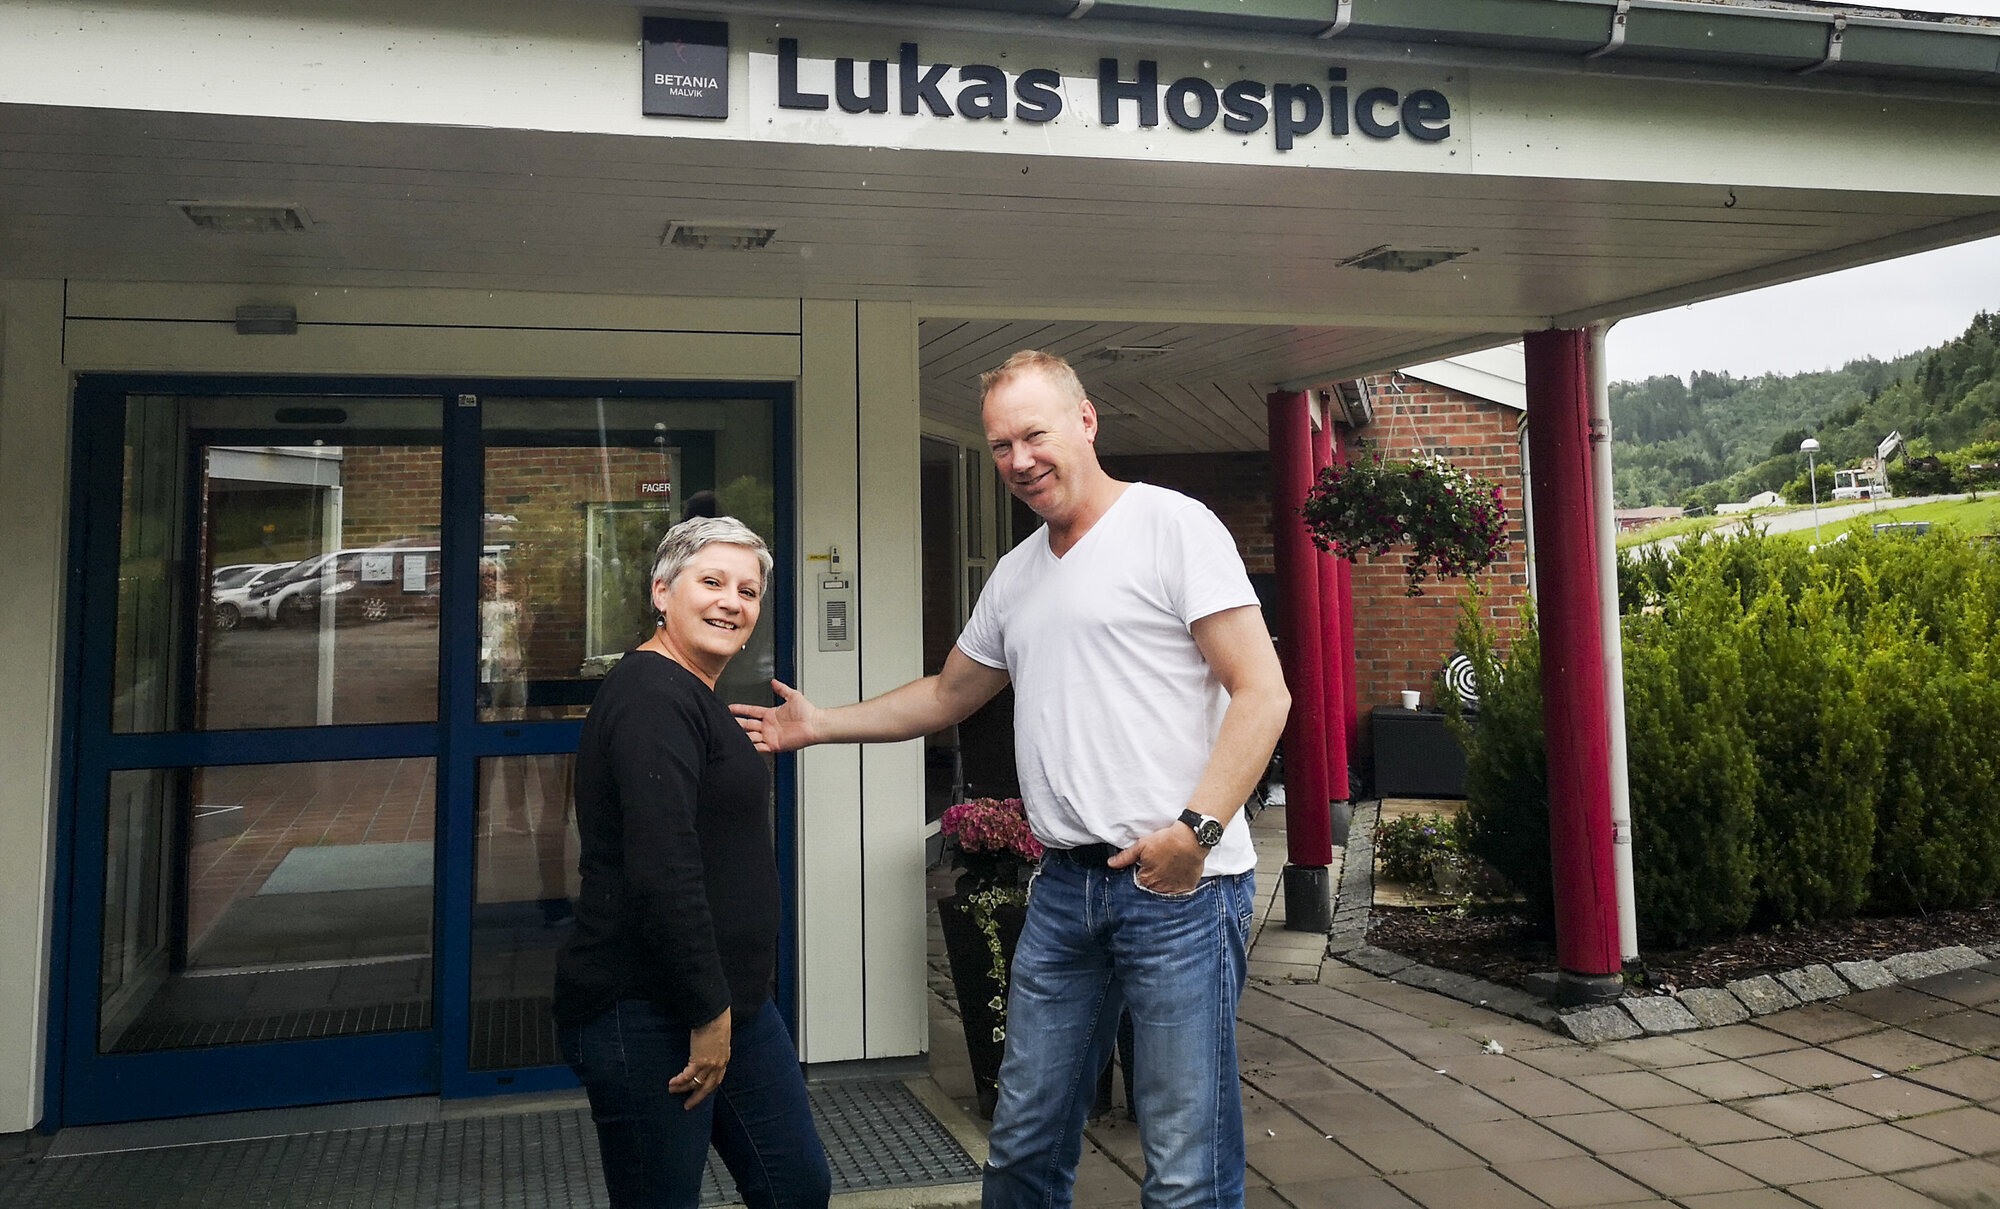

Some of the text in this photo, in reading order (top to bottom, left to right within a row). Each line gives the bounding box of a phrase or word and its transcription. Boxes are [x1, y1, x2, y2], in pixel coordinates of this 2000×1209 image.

[654, 73, 719, 89] BETANIA
[669, 87, 703, 98] MALVIK
[778, 37, 1451, 151] Lukas Hospice
[641, 483, 671, 493] FAGER
